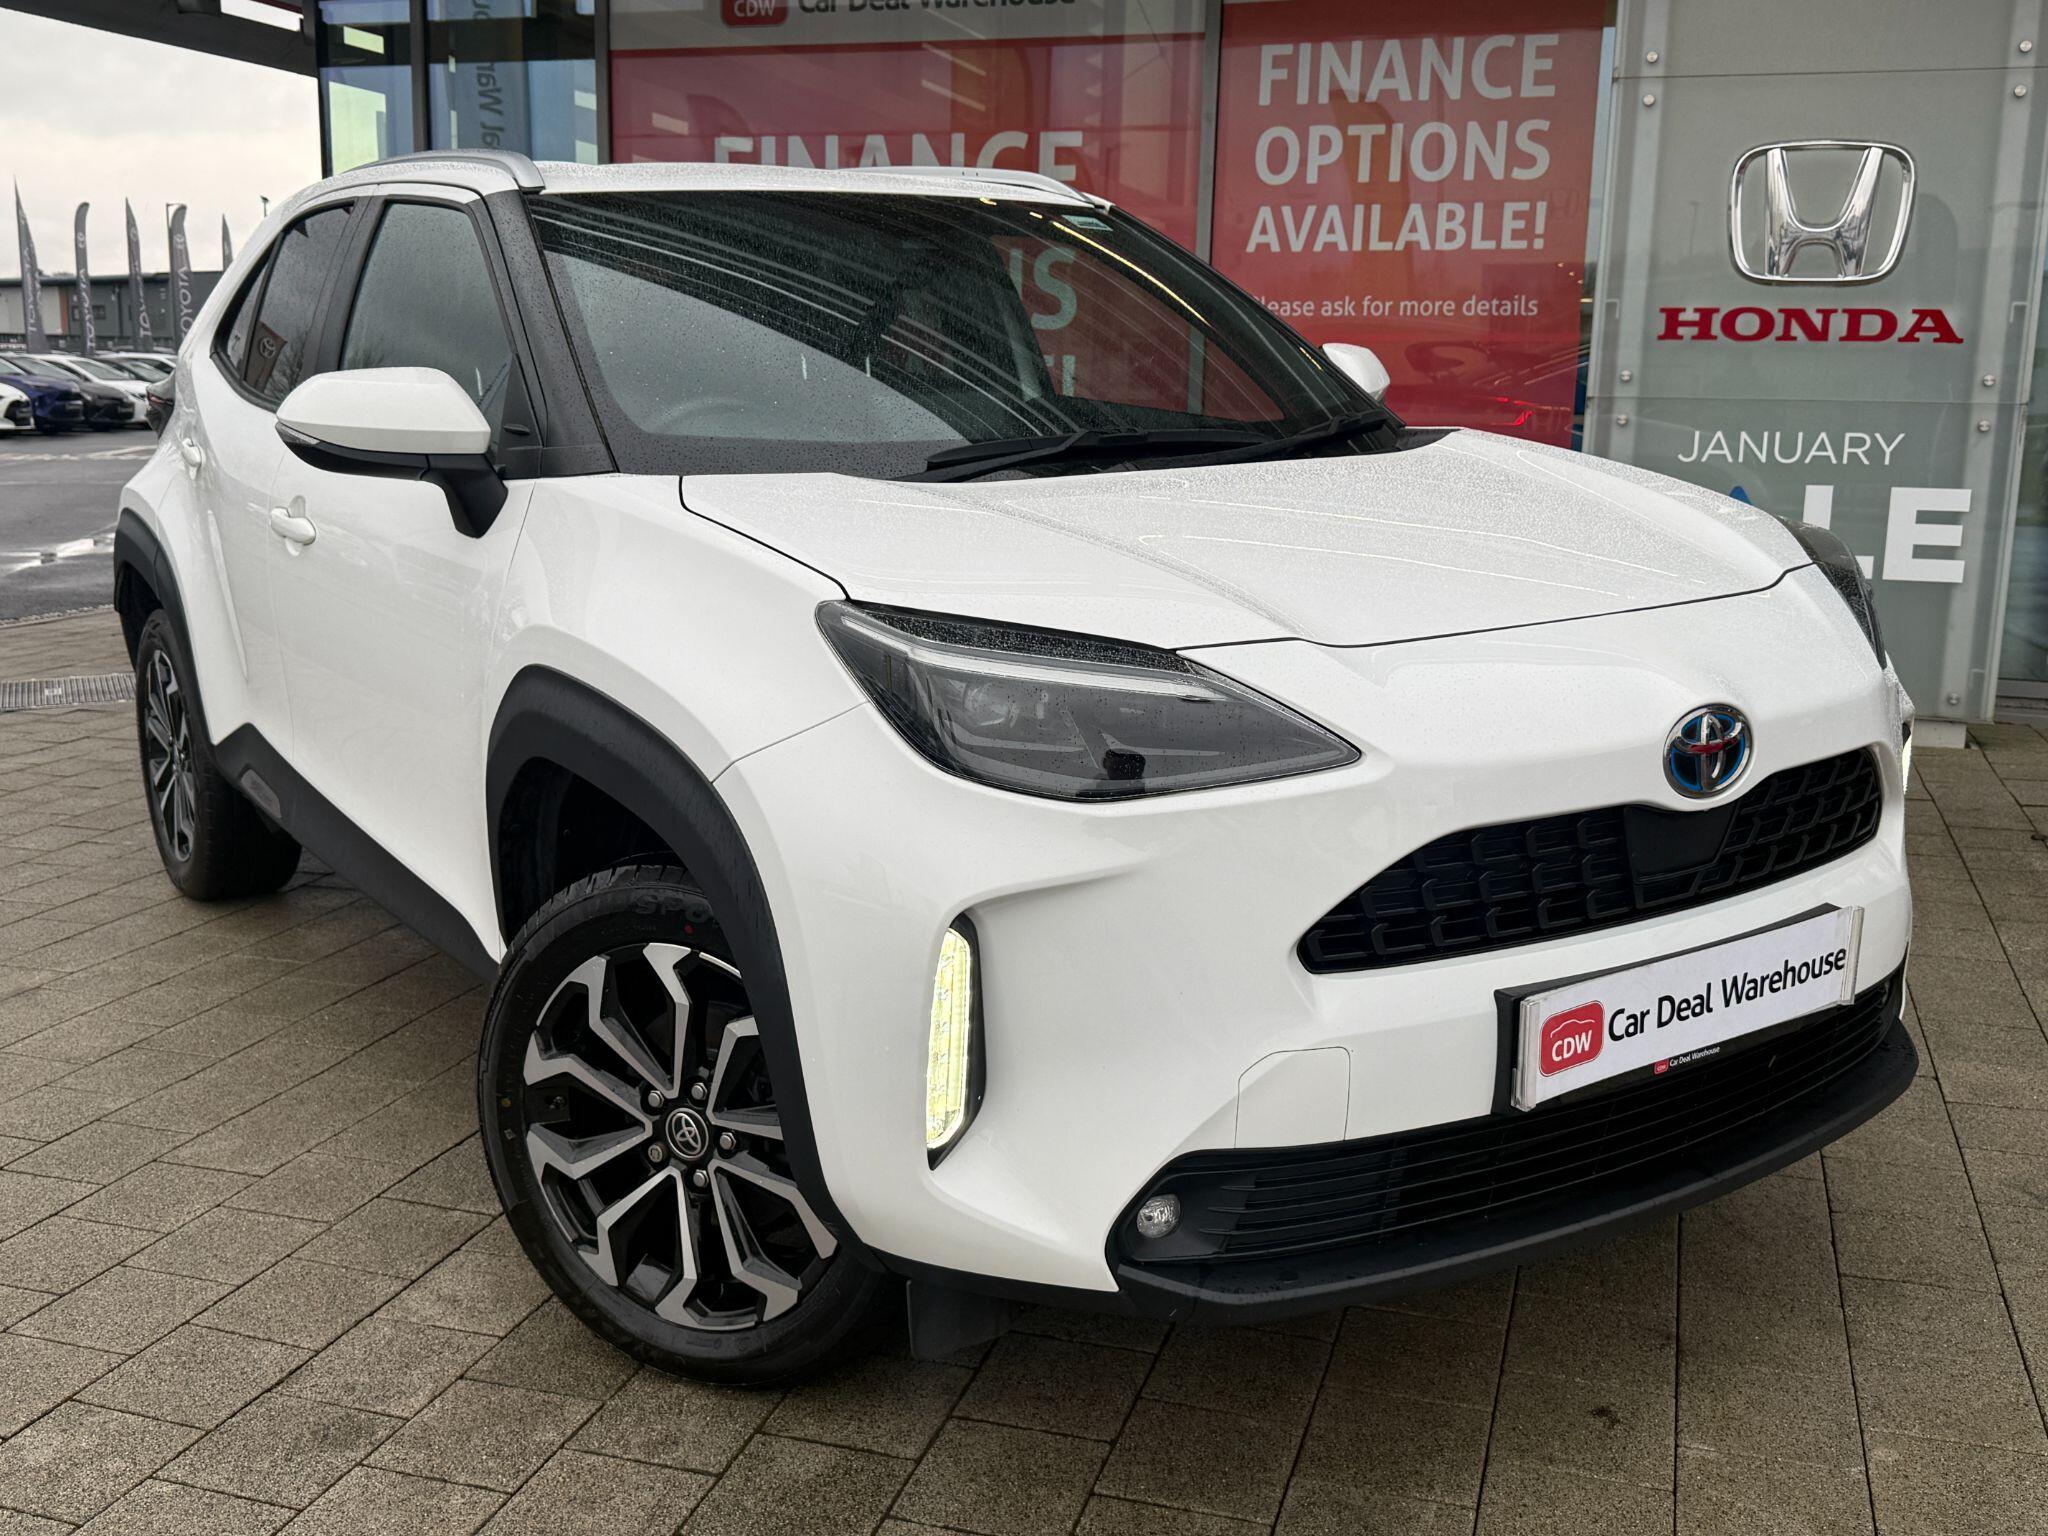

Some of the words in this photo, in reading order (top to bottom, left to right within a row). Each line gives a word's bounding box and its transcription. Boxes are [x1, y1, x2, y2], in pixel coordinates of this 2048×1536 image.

[734, 0, 775, 17] CDW
[1259, 34, 1559, 106] FINANCE
[1255, 119, 1551, 186] OPTIONS
[1246, 201, 1547, 252] AVAILABLE!
[177, 266, 194, 339] OYOTA
[1254, 295, 1315, 316] lease
[1321, 296, 1356, 316] ask
[1362, 296, 1393, 316] for
[1399, 299, 1456, 316] more
[1462, 294, 1538, 316] details
[1657, 306, 1964, 344] HONDA
[1677, 430, 1906, 466] JANUARY
[1608, 1007, 1650, 1042] Car
[1657, 983, 1713, 1029] Deal
[1721, 948, 1847, 1008] Warehouse
[1551, 1029, 1593, 1062] CDW
